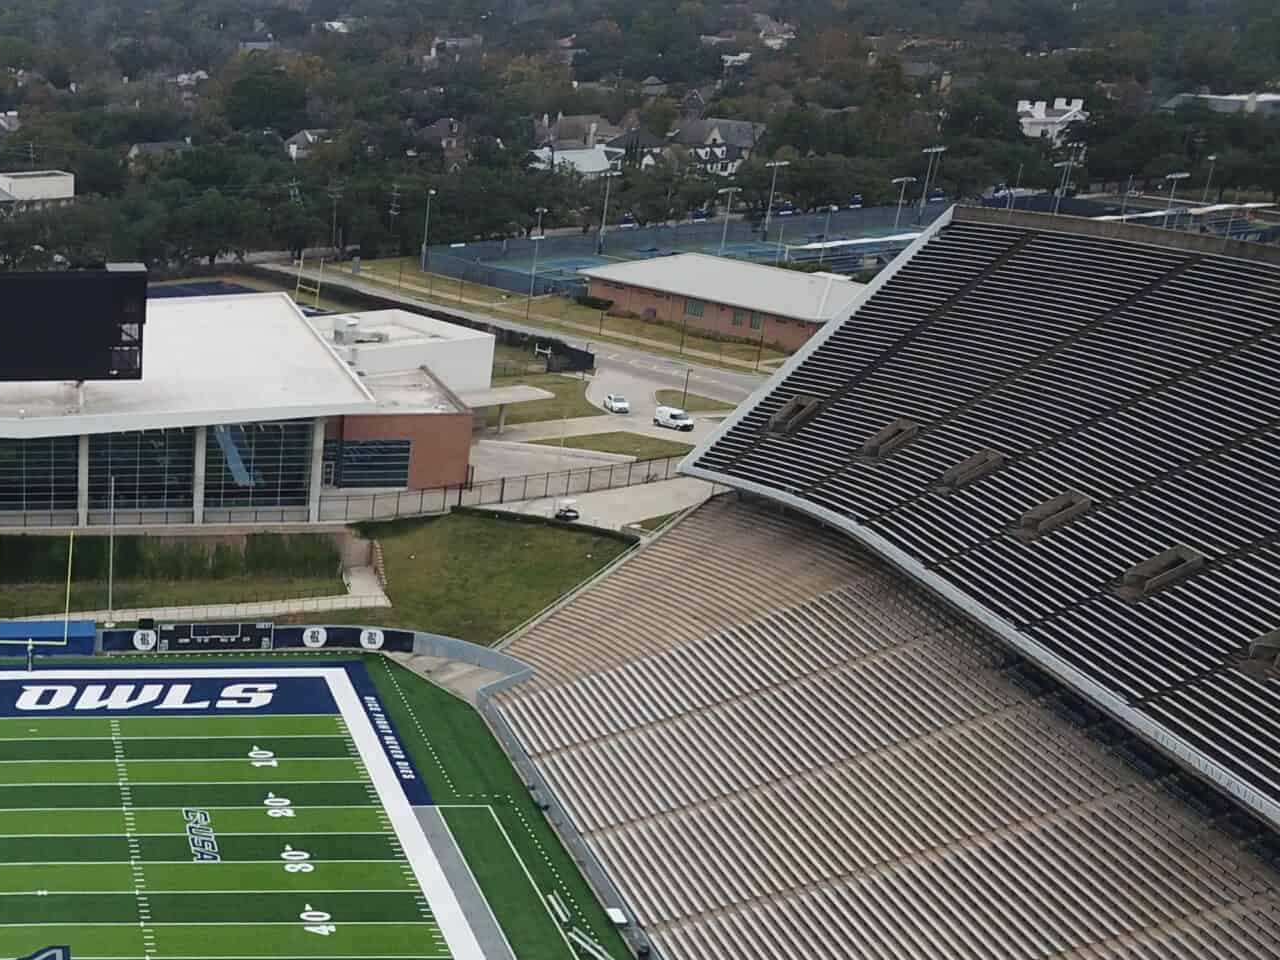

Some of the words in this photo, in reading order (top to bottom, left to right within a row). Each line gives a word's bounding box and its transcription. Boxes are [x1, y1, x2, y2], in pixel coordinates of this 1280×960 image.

[16, 684, 277, 711] OWLS
[248, 751, 278, 767] 10
[281, 850, 314, 873] 30
[301, 911, 336, 936] 40
